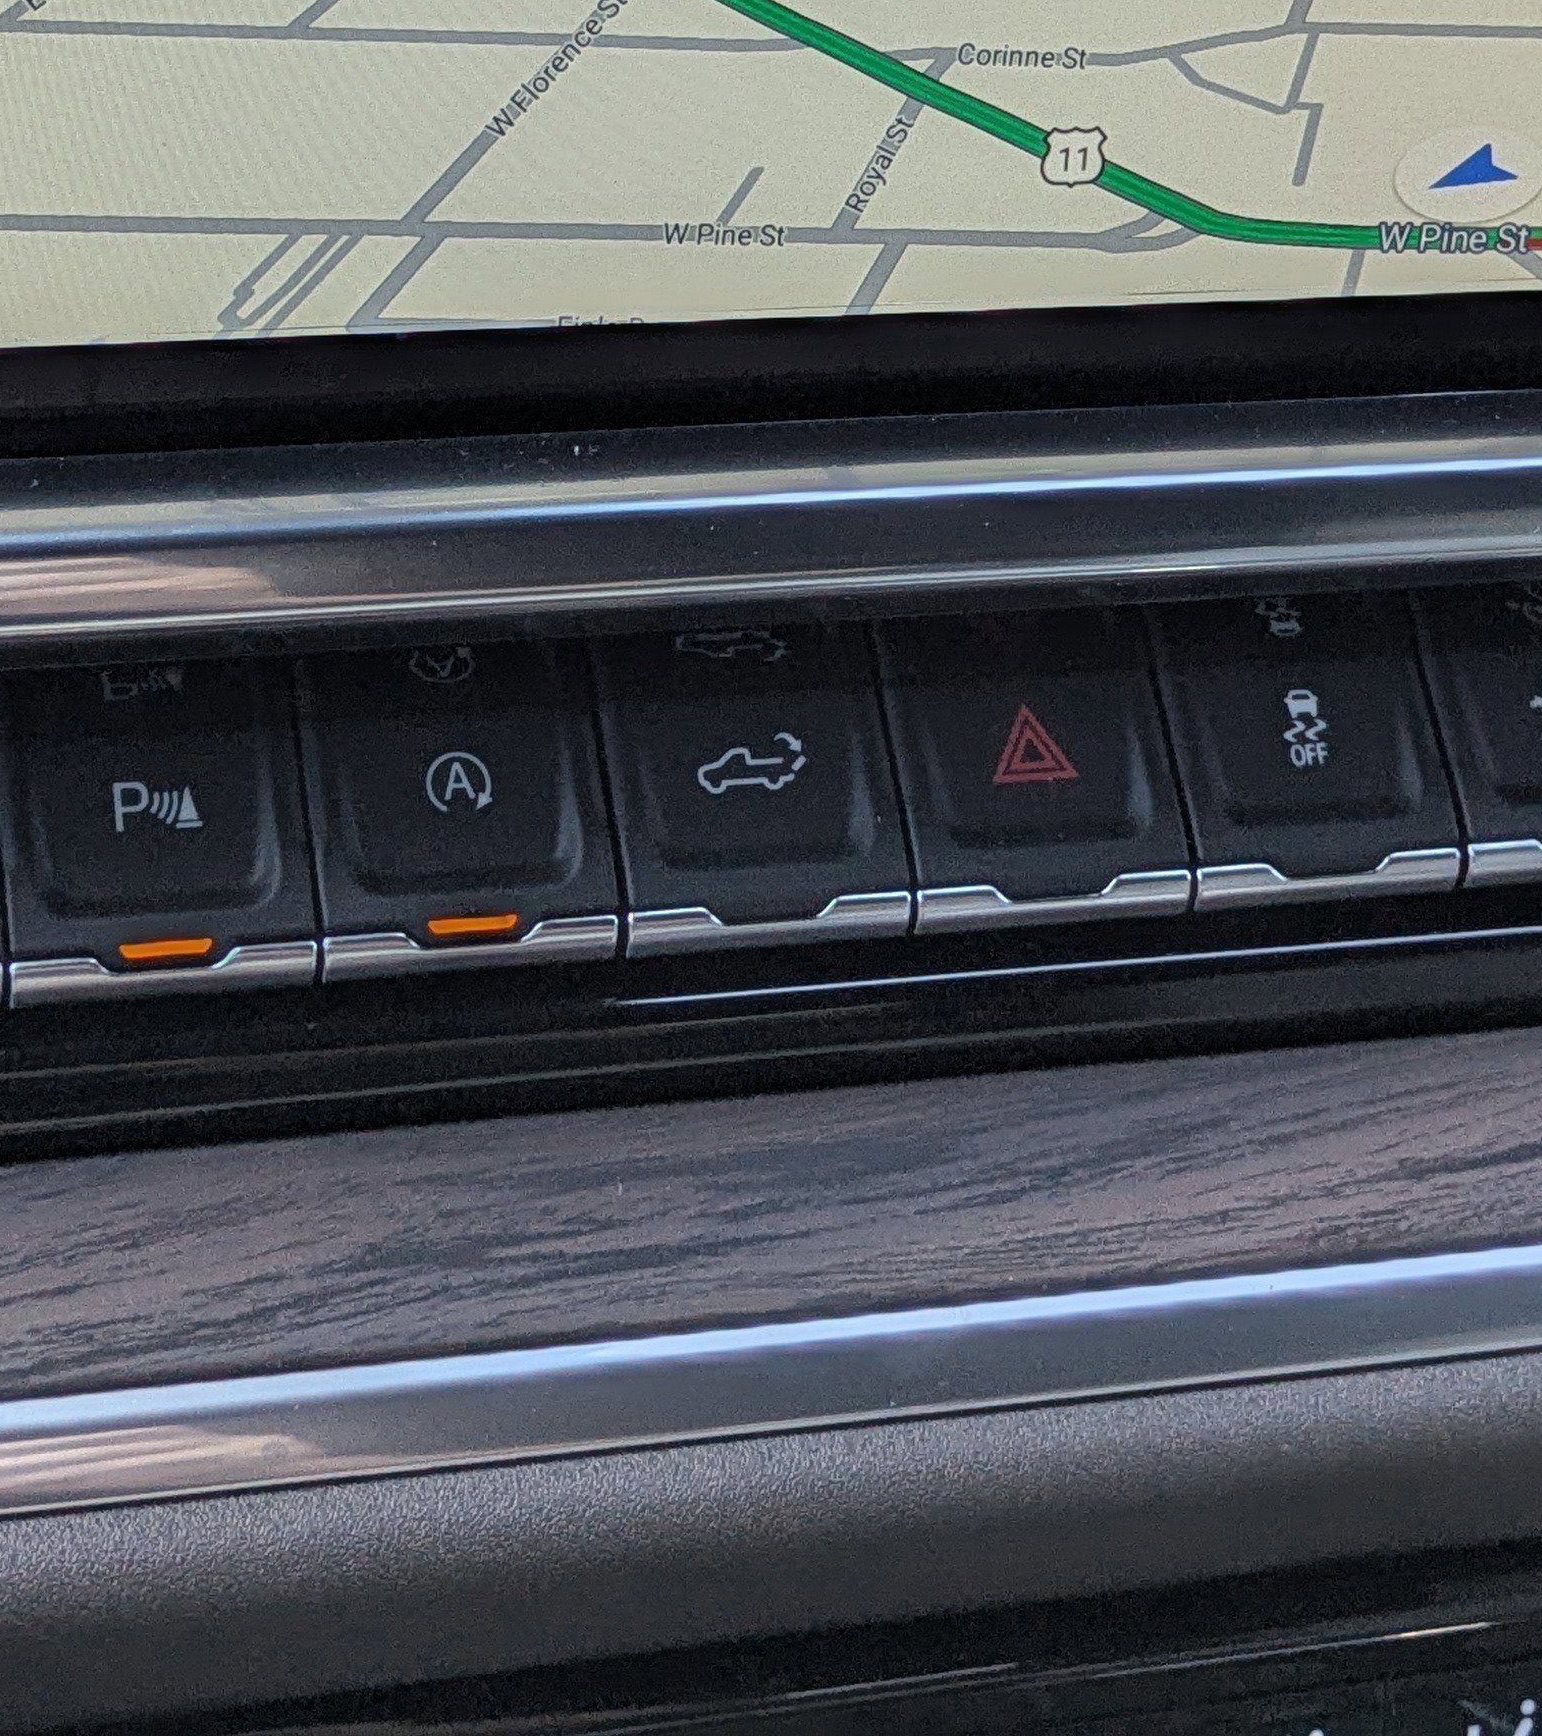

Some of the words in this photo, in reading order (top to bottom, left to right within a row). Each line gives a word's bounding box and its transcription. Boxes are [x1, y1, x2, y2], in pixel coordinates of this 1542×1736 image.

[958, 42, 1054, 69] Corinne
[1059, 45, 1088, 70] St
[487, 104, 517, 139] W
[507, 10, 608, 119] Florence
[844, 145, 898, 214] Royal
[885, 115, 915, 149] St
[1058, 145, 1090, 173] 11
[663, 222, 694, 246] W
[697, 222, 753, 246] Pine
[758, 224, 785, 248] St
[1378, 225, 1412, 253] W
[1419, 223, 1488, 252] Pine
[1497, 224, 1530, 253] St
[1291, 743, 1328, 767] OFF
